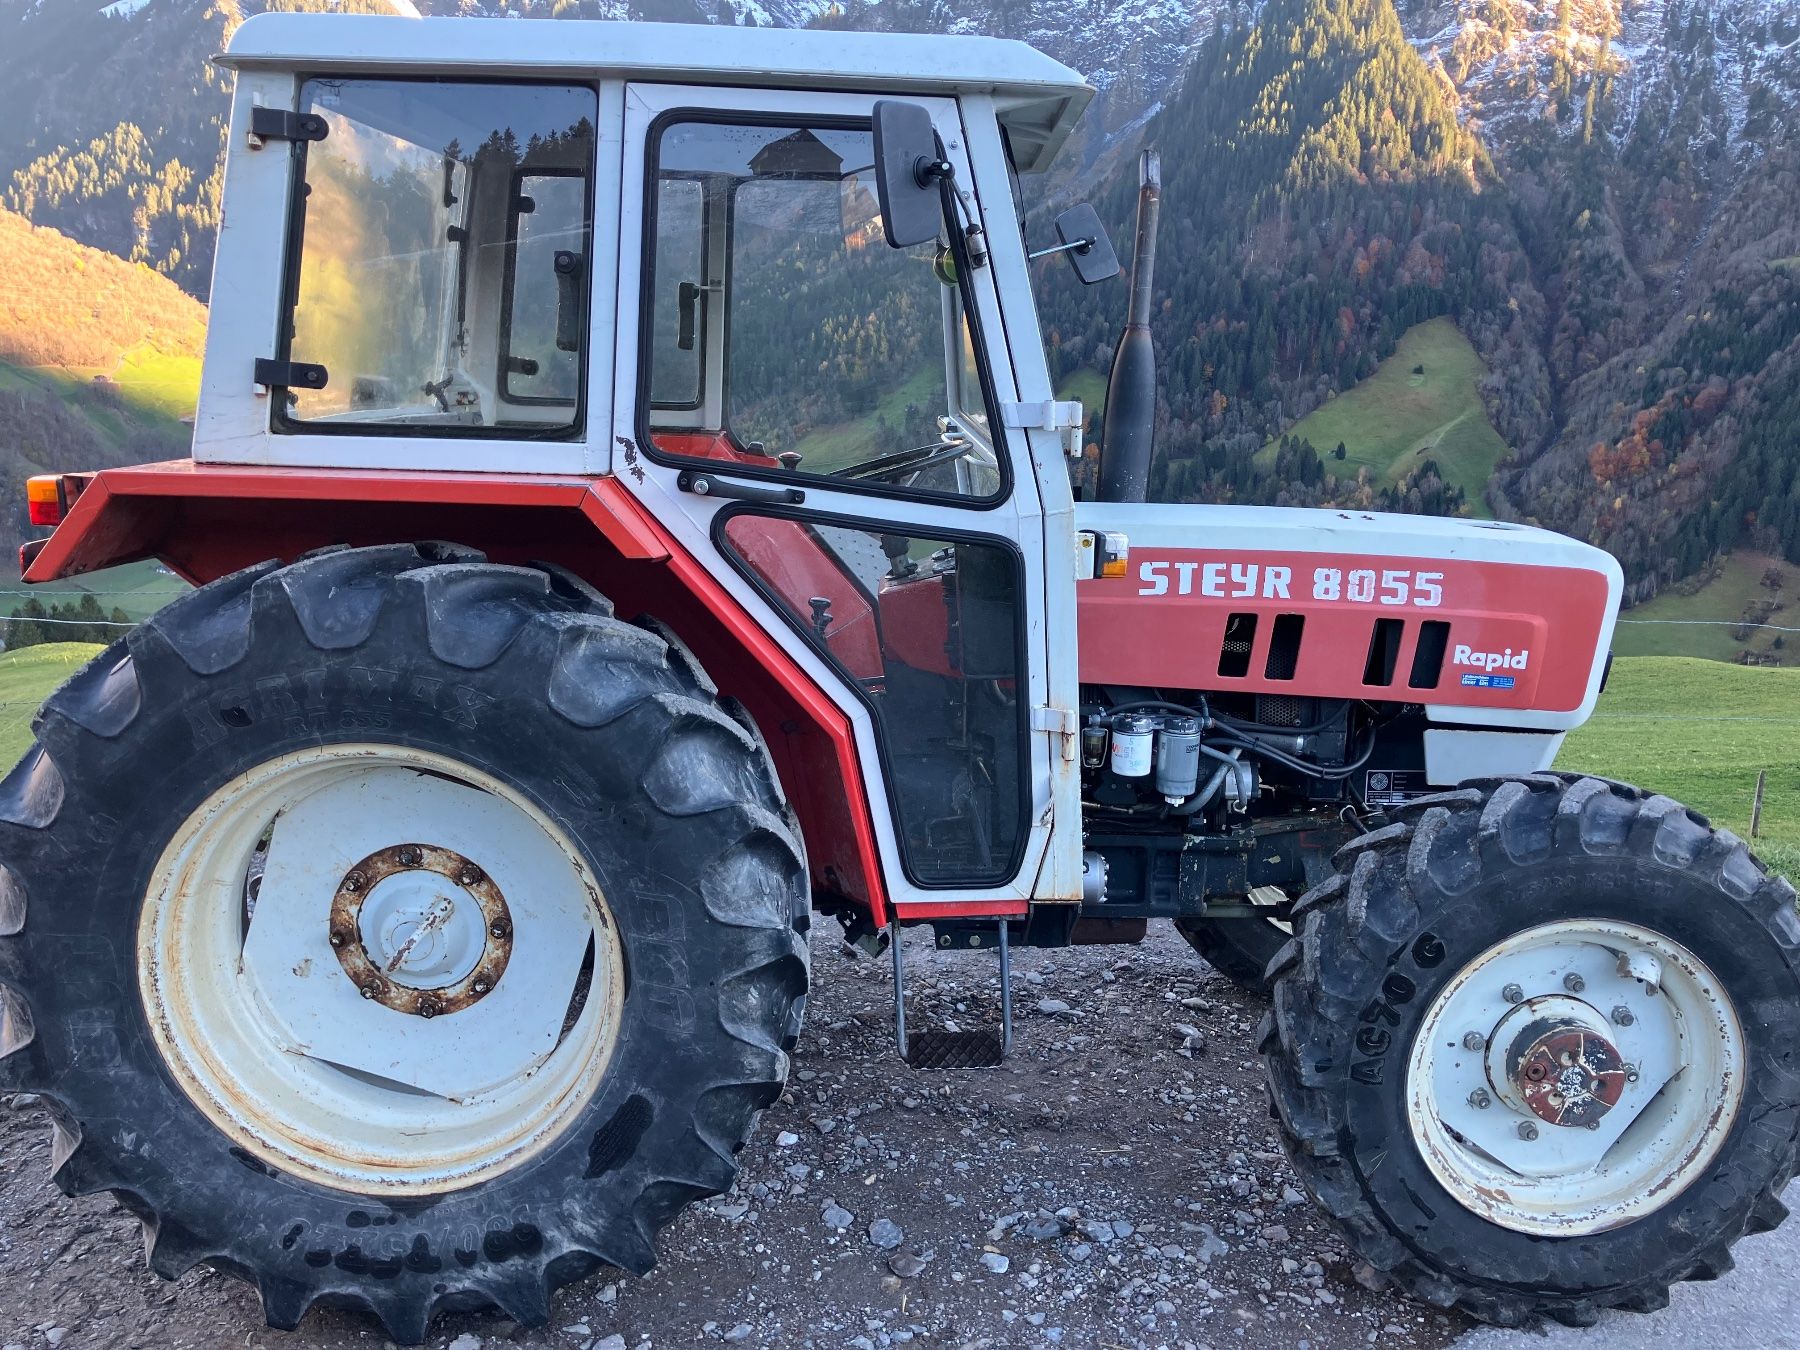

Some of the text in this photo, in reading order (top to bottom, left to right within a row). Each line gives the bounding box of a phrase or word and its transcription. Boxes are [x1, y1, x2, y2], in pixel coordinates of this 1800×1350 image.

[1138, 562, 1444, 607] STEYR 8055
[1453, 644, 1529, 671] Rapid
